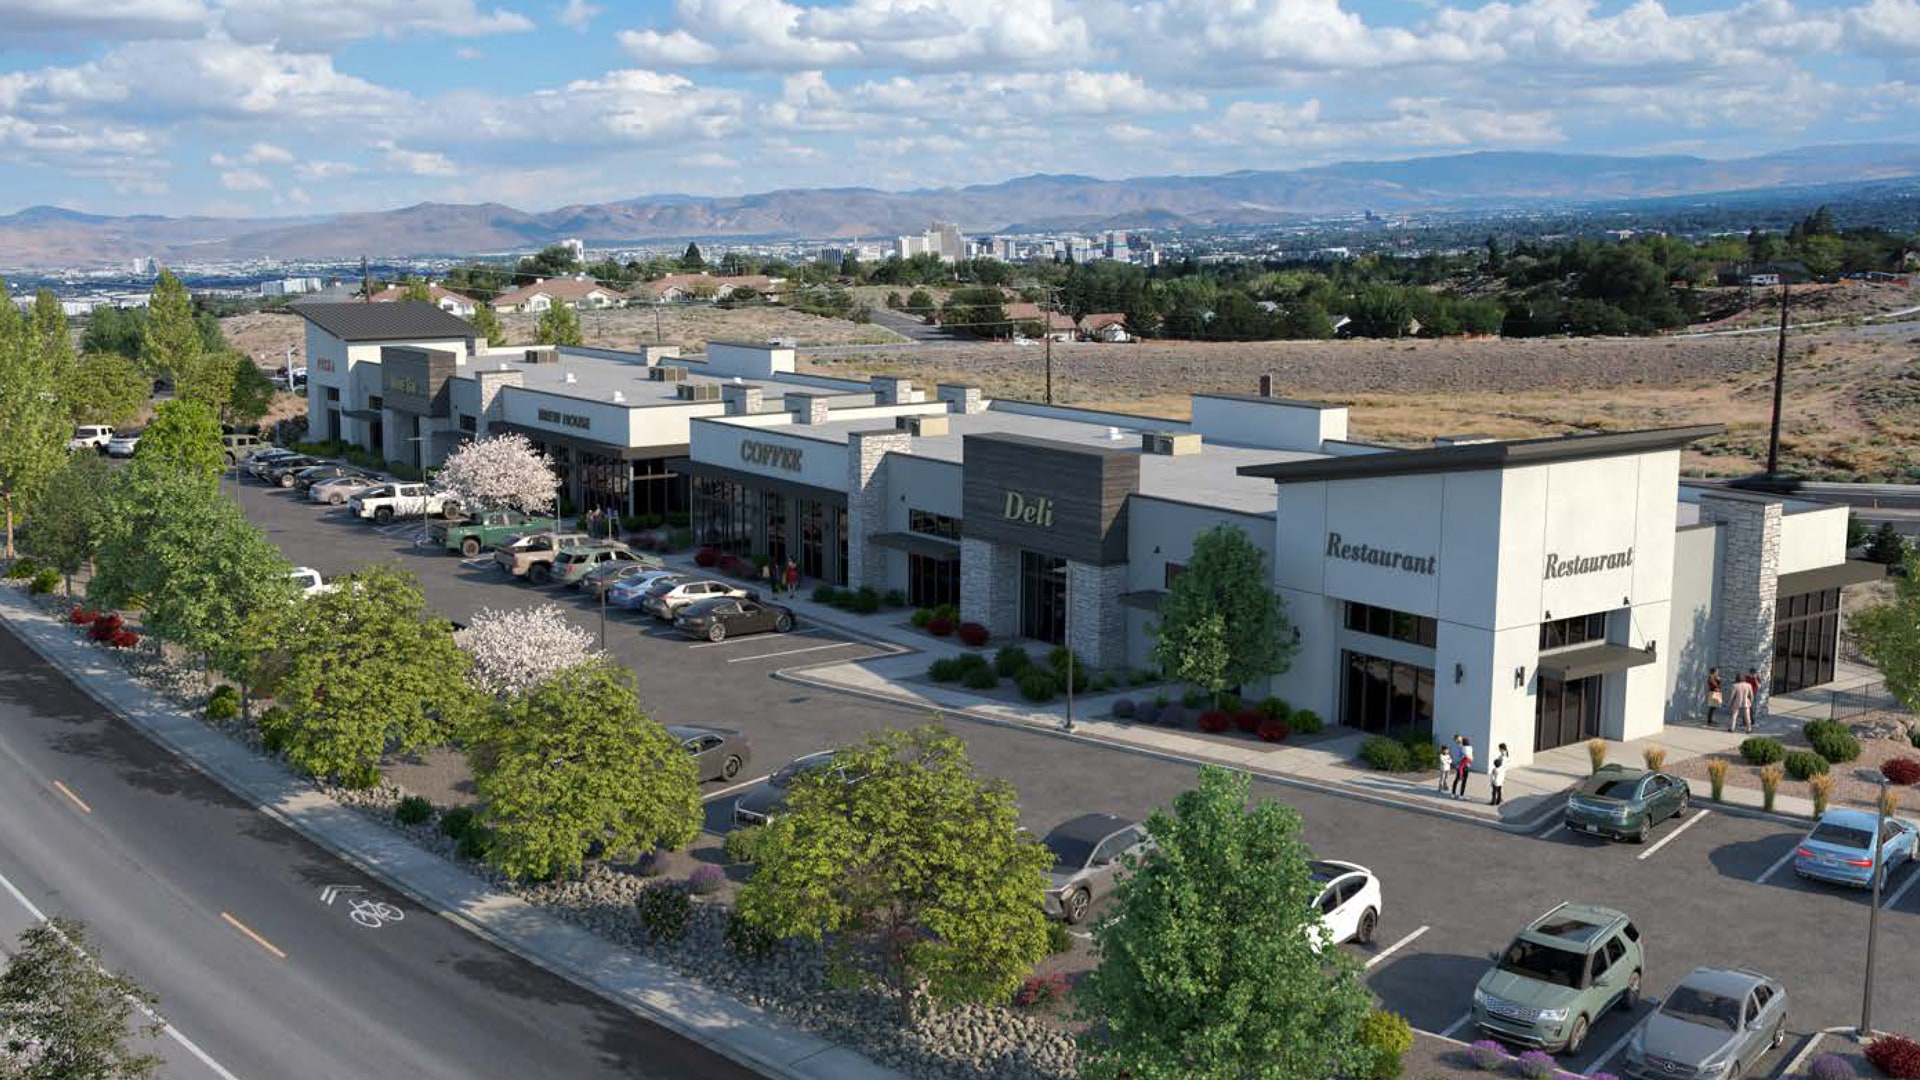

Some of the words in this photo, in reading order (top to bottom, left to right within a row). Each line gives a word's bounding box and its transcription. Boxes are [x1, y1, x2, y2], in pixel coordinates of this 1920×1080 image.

[742, 439, 803, 472] COFFEE
[1003, 490, 1054, 527] Deli
[1326, 531, 1437, 575] Restaurant
[1543, 546, 1633, 580] Restaurant
